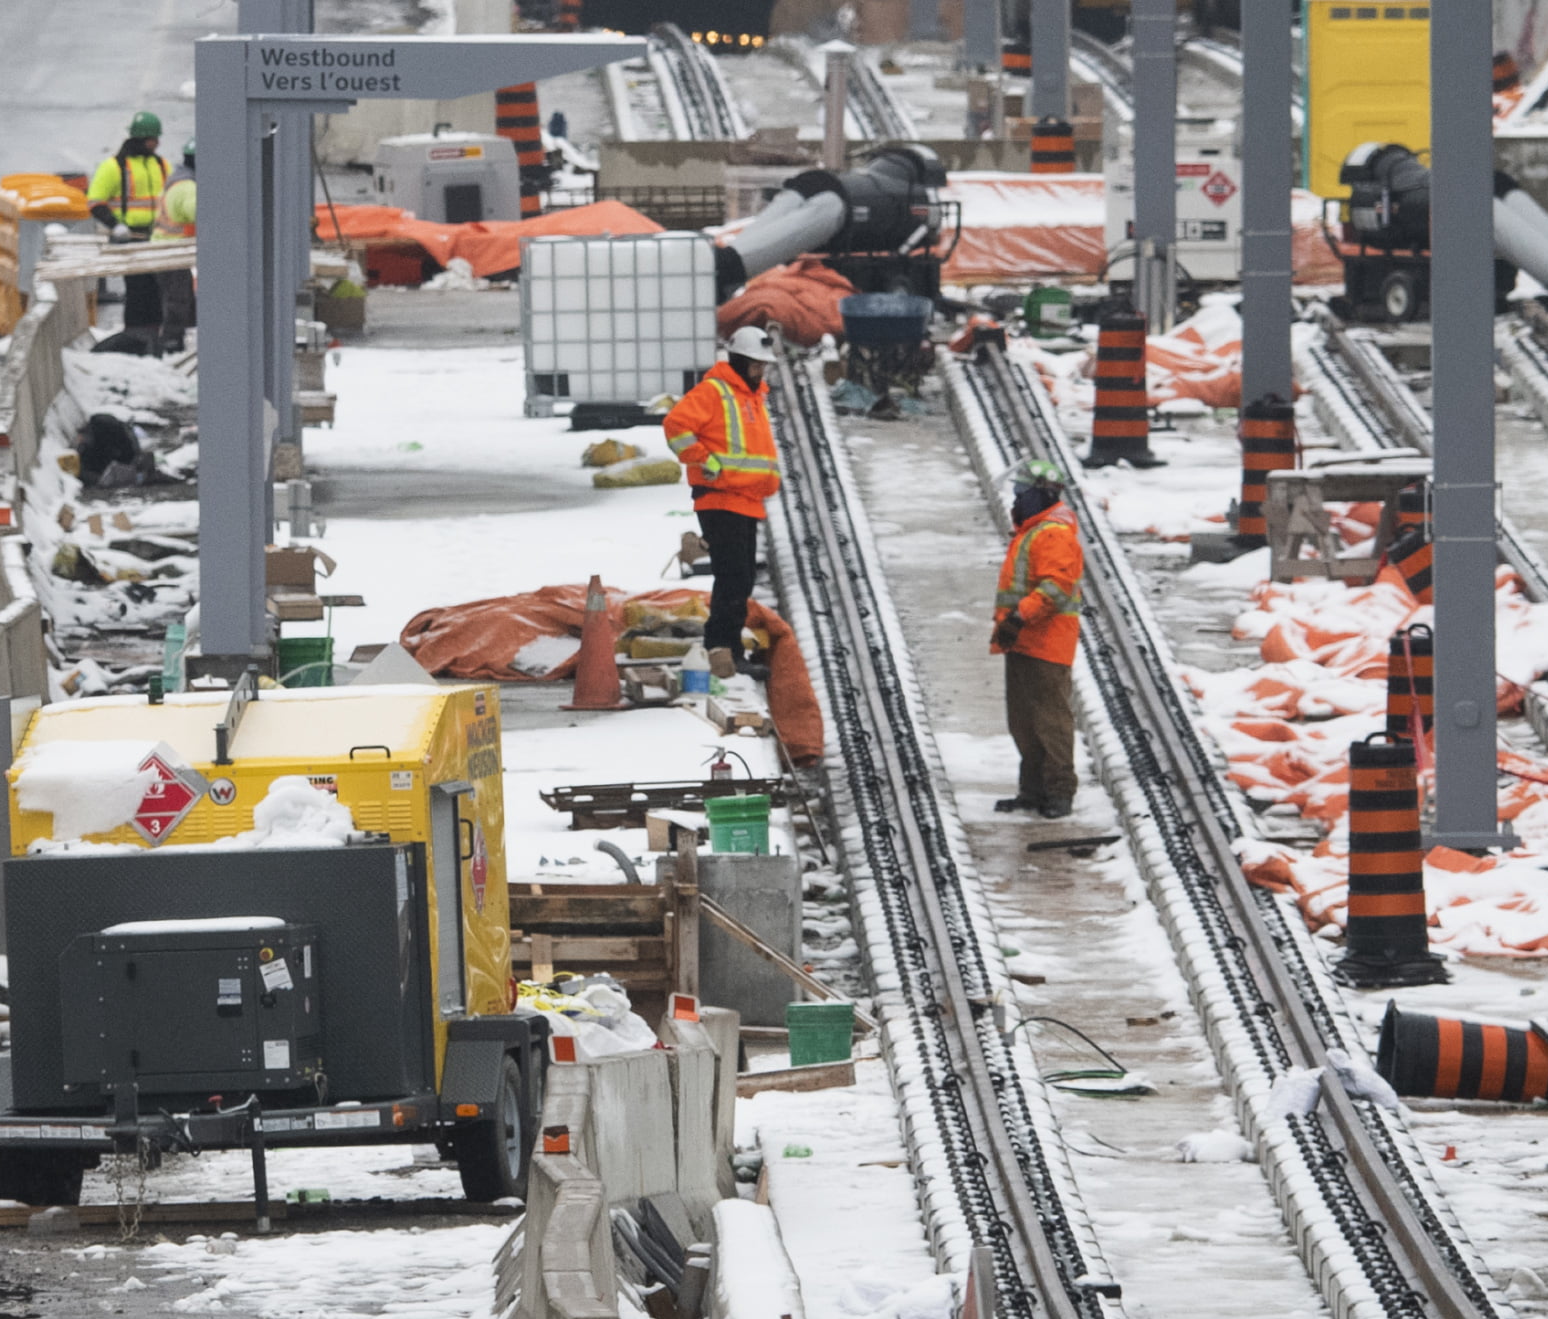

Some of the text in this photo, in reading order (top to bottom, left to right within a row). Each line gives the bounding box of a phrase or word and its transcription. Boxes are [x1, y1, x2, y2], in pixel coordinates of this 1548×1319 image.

[260, 47, 396, 68] Westbound
[261, 71, 313, 92] Vers
[150, 819, 161, 833] 3
